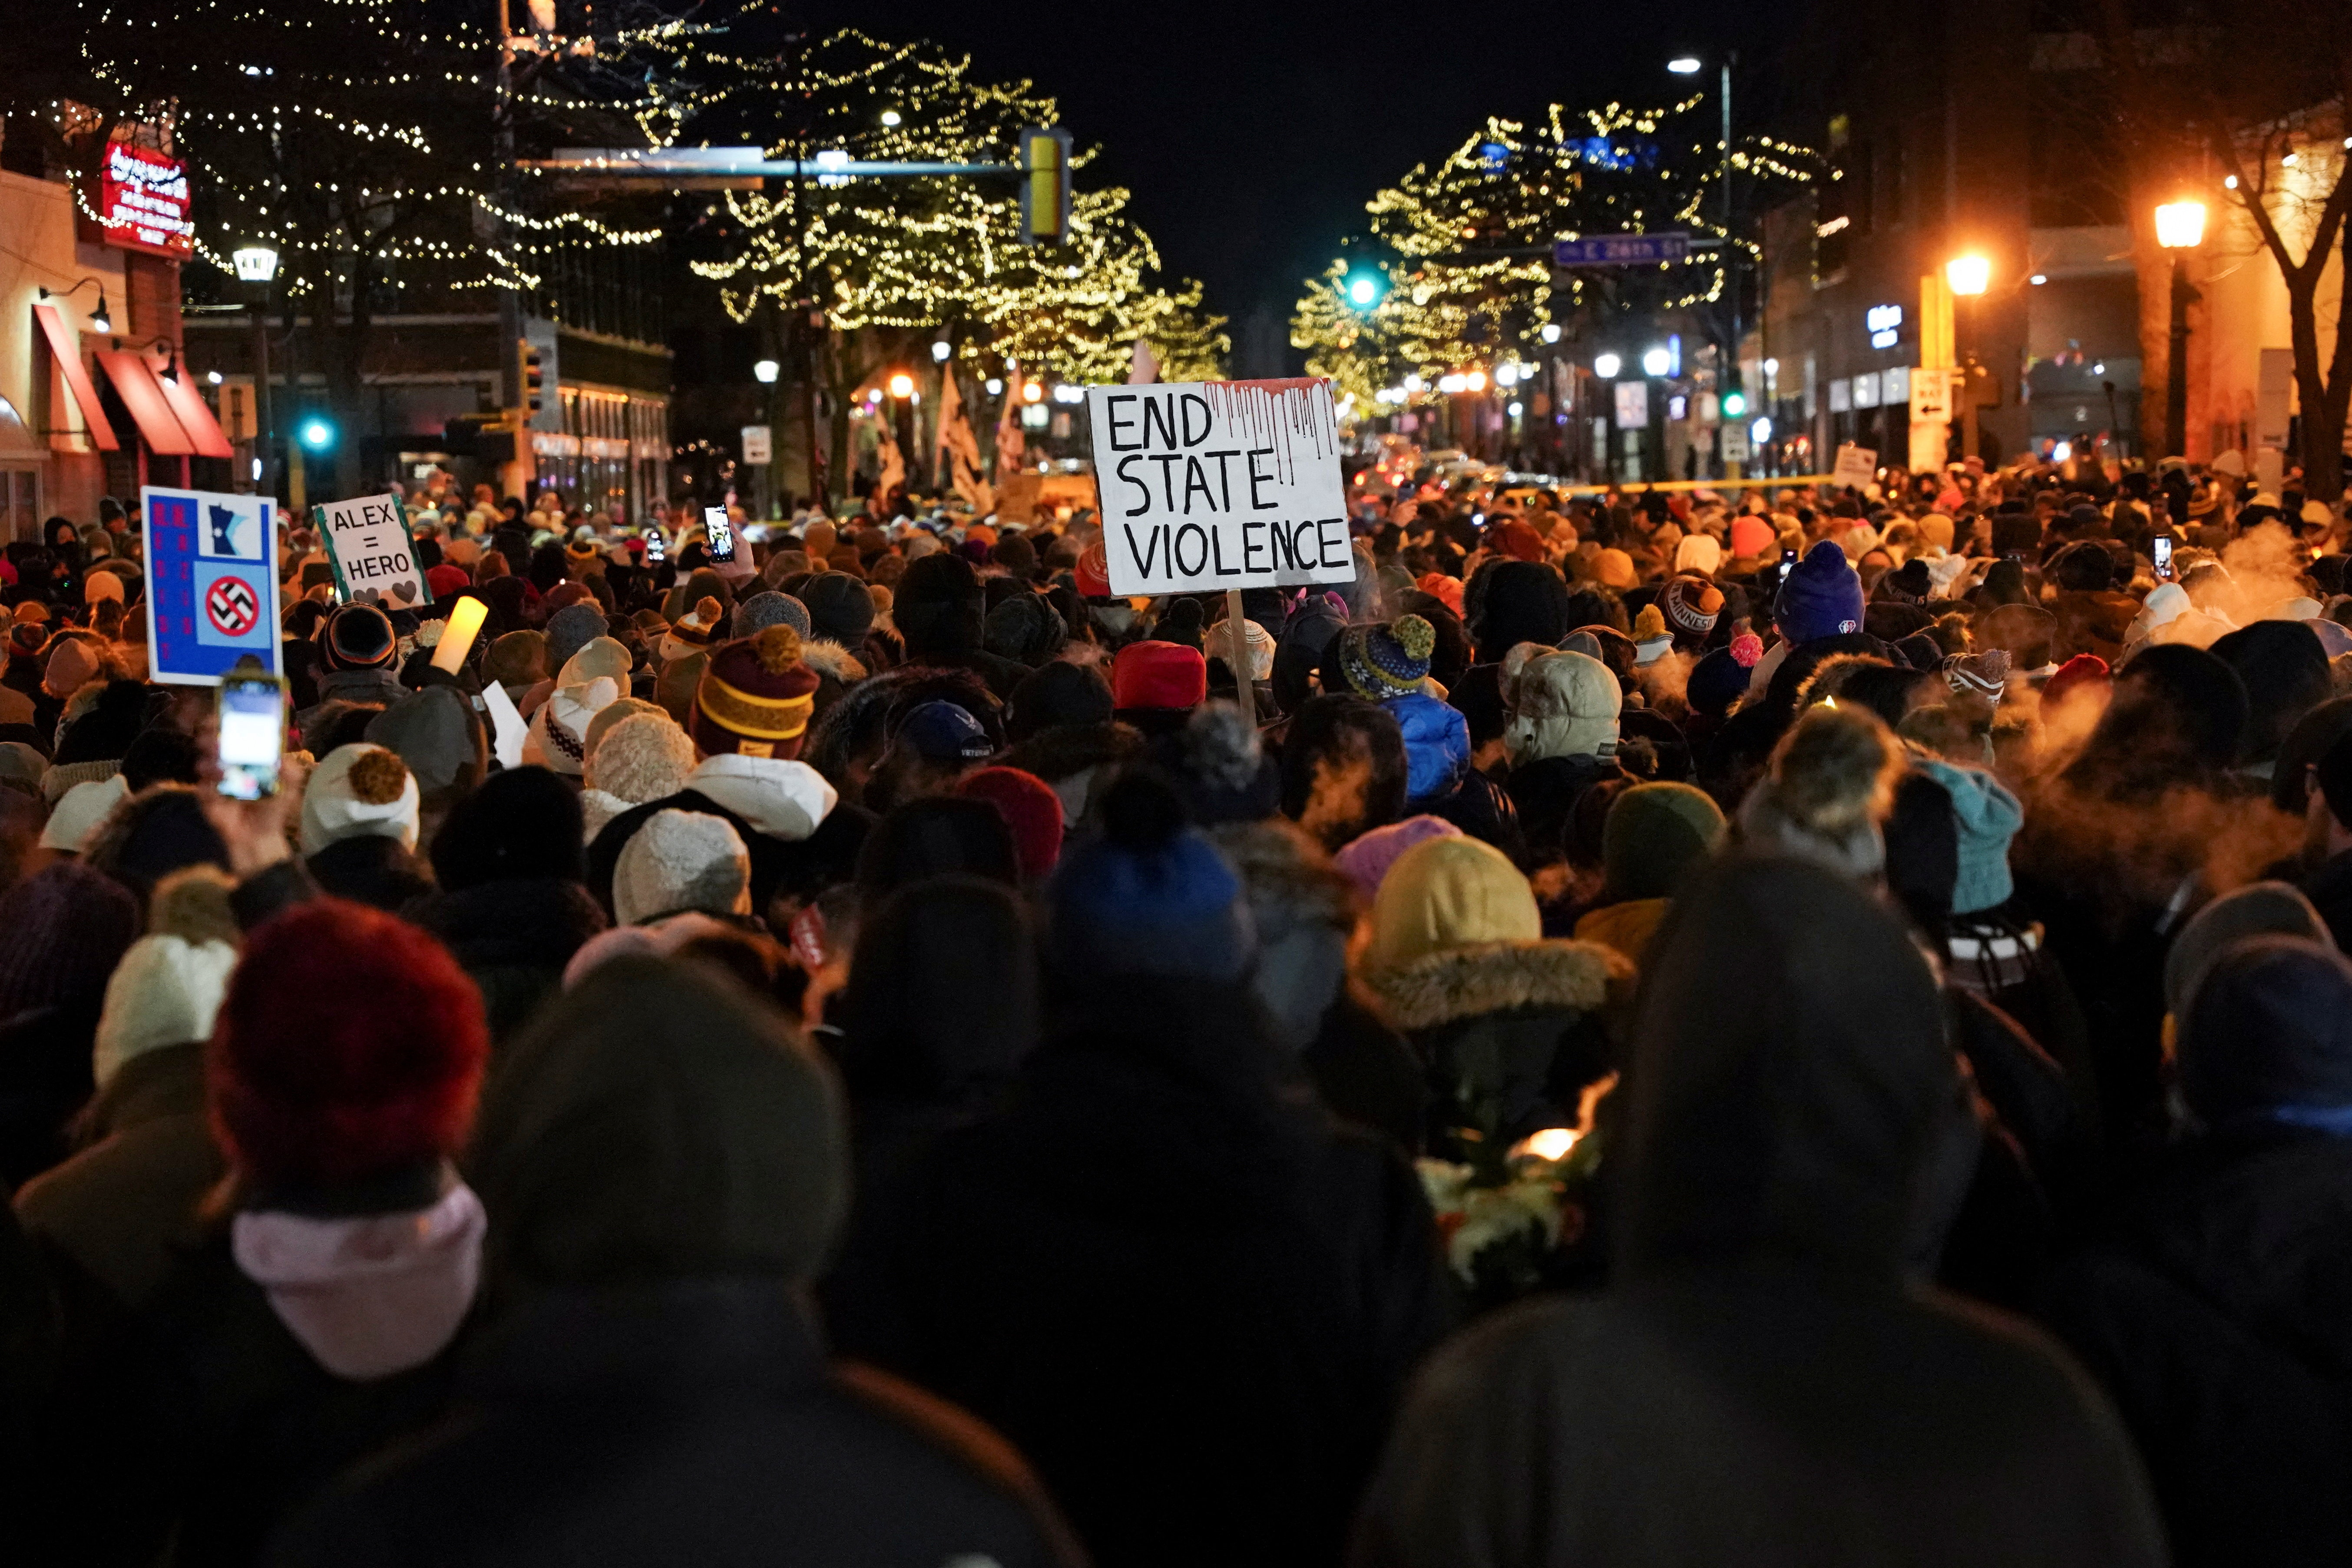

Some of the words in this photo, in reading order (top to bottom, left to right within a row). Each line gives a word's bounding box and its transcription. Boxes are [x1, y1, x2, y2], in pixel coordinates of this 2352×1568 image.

[1108, 393, 1212, 451] END
[1117, 448, 1278, 516] STATE
[334, 503, 394, 531] ALEX
[363, 536, 379, 548] =
[1124, 518, 1349, 579] VIOLENCE
[347, 553, 409, 580] HERO
[1671, 595, 1716, 628] MINNESO
